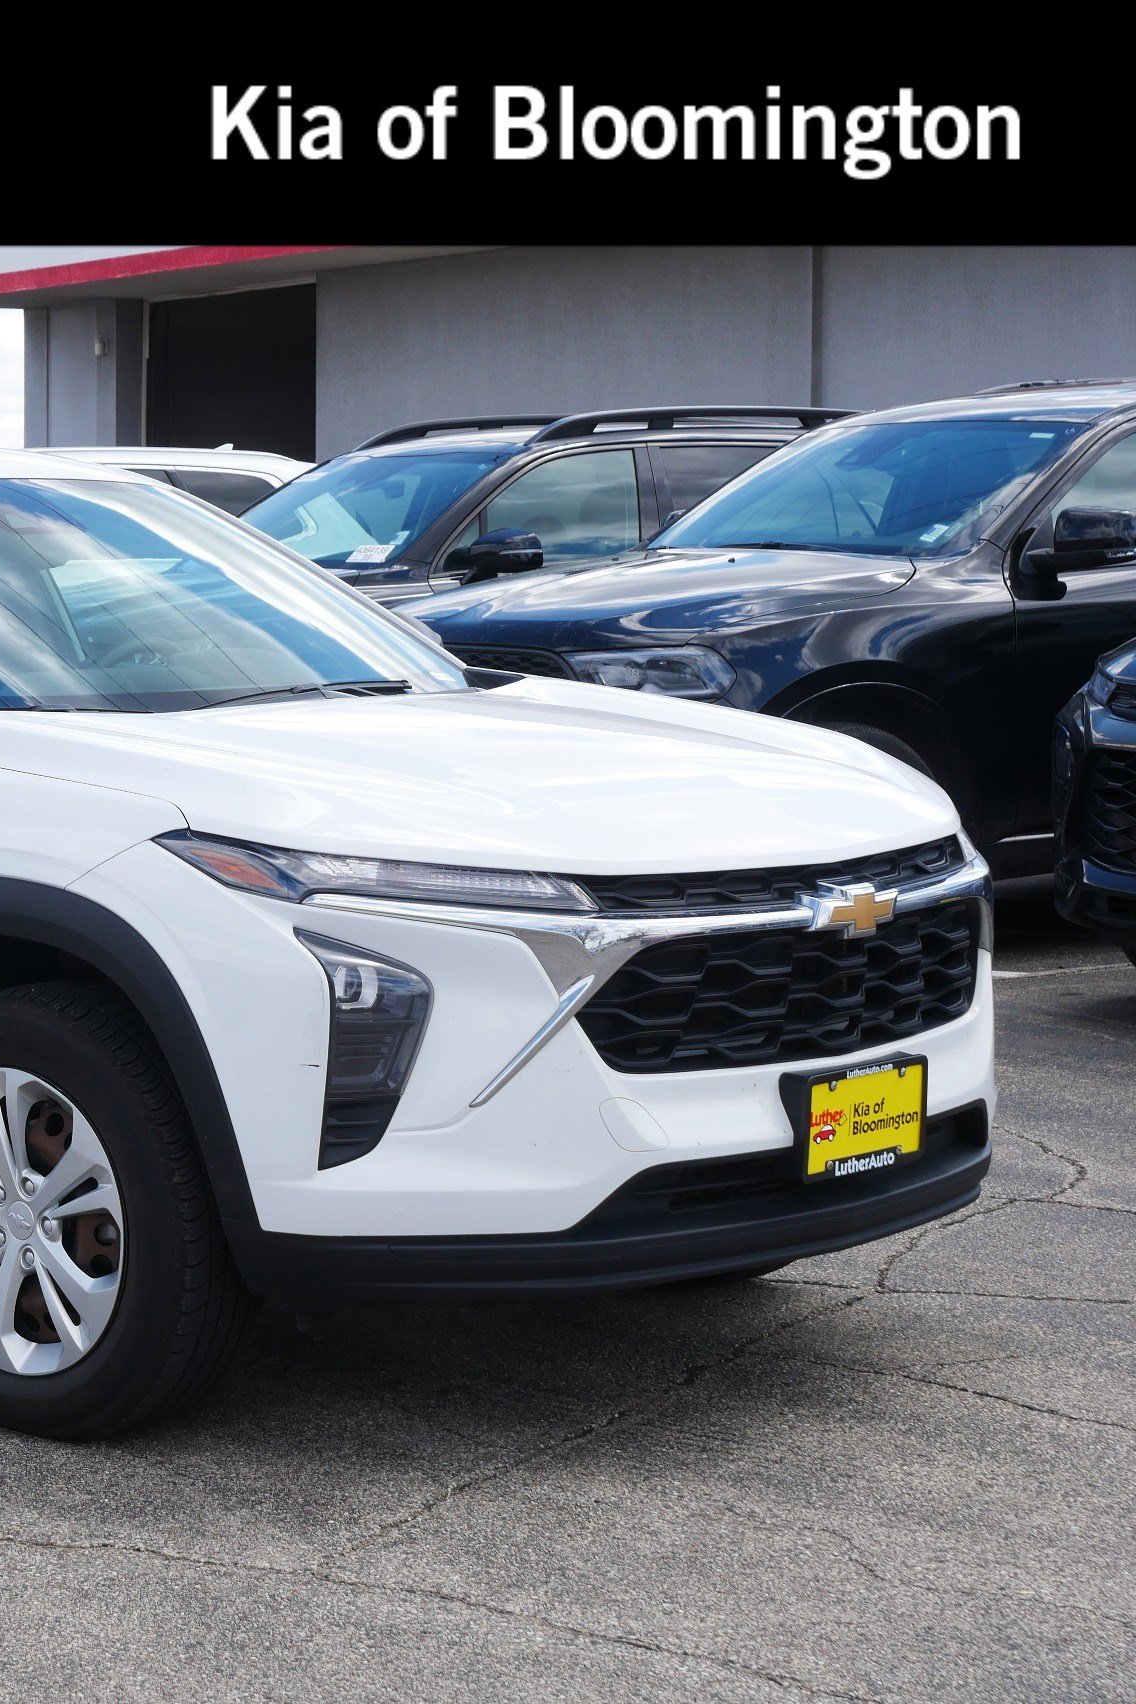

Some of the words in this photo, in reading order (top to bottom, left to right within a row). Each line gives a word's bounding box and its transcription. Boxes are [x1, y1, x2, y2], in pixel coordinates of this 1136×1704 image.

[846, 1063, 893, 1078] LutherAuto.com
[809, 1109, 844, 1127] Luther
[853, 1102, 869, 1118] Kia
[873, 1097, 885, 1112] of
[852, 1110, 918, 1135] Bloomington
[834, 1151, 895, 1176] LutherAuto
